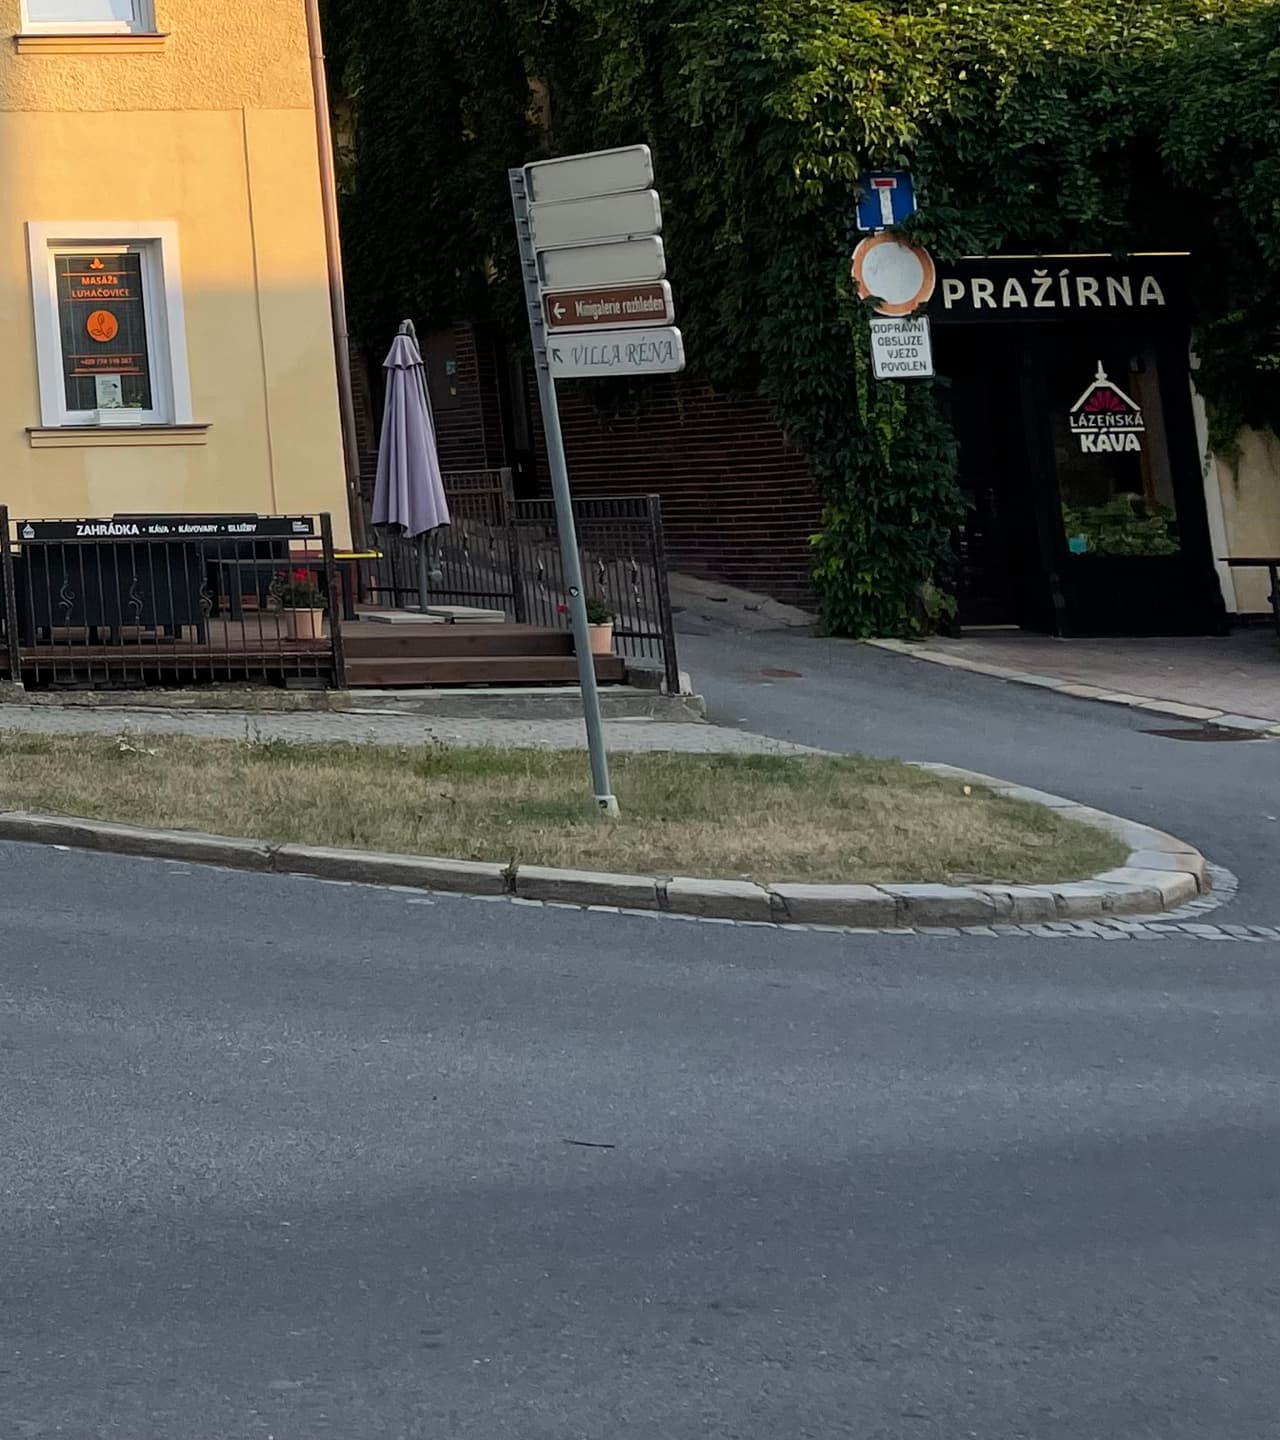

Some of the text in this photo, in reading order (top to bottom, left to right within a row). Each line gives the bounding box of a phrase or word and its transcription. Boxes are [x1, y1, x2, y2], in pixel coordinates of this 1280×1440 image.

[942, 268, 1165, 309] PRAŽÍRNA
[575, 297, 621, 320] Minigalerie
[877, 336, 923, 346] OBSLUZE
[571, 336, 675, 367] VILLA RÉNA
[887, 348, 918, 358] VJEZD
[881, 361, 927, 371] POVOLEN
[1070, 412, 1144, 427] LÁZEŇSKÁ
[1080, 428, 1141, 452] KÁVA
[76, 522, 139, 535] ZAHRÁDKA
